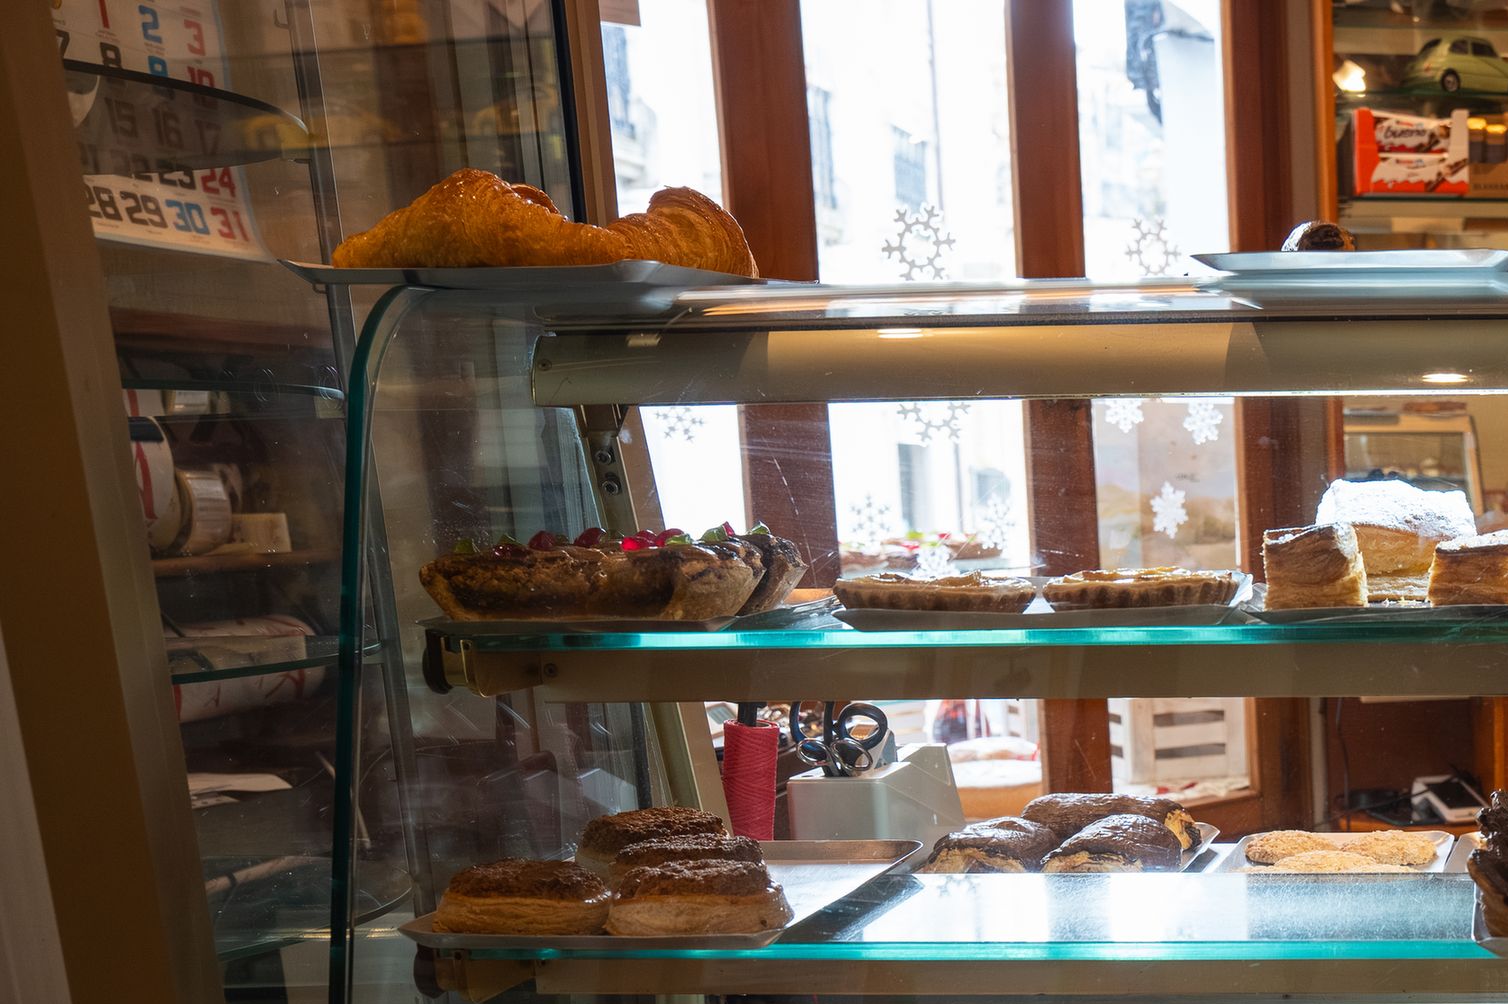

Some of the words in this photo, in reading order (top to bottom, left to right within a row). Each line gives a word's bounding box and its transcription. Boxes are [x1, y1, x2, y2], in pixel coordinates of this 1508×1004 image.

[138, 5, 163, 44] 2
[184, 19, 206, 56] 3
[1383, 125, 1428, 140] bueno
[199, 165, 237, 200] 24
[119, 190, 169, 230] 29
[164, 198, 211, 236] 30
[209, 205, 251, 243] 31
